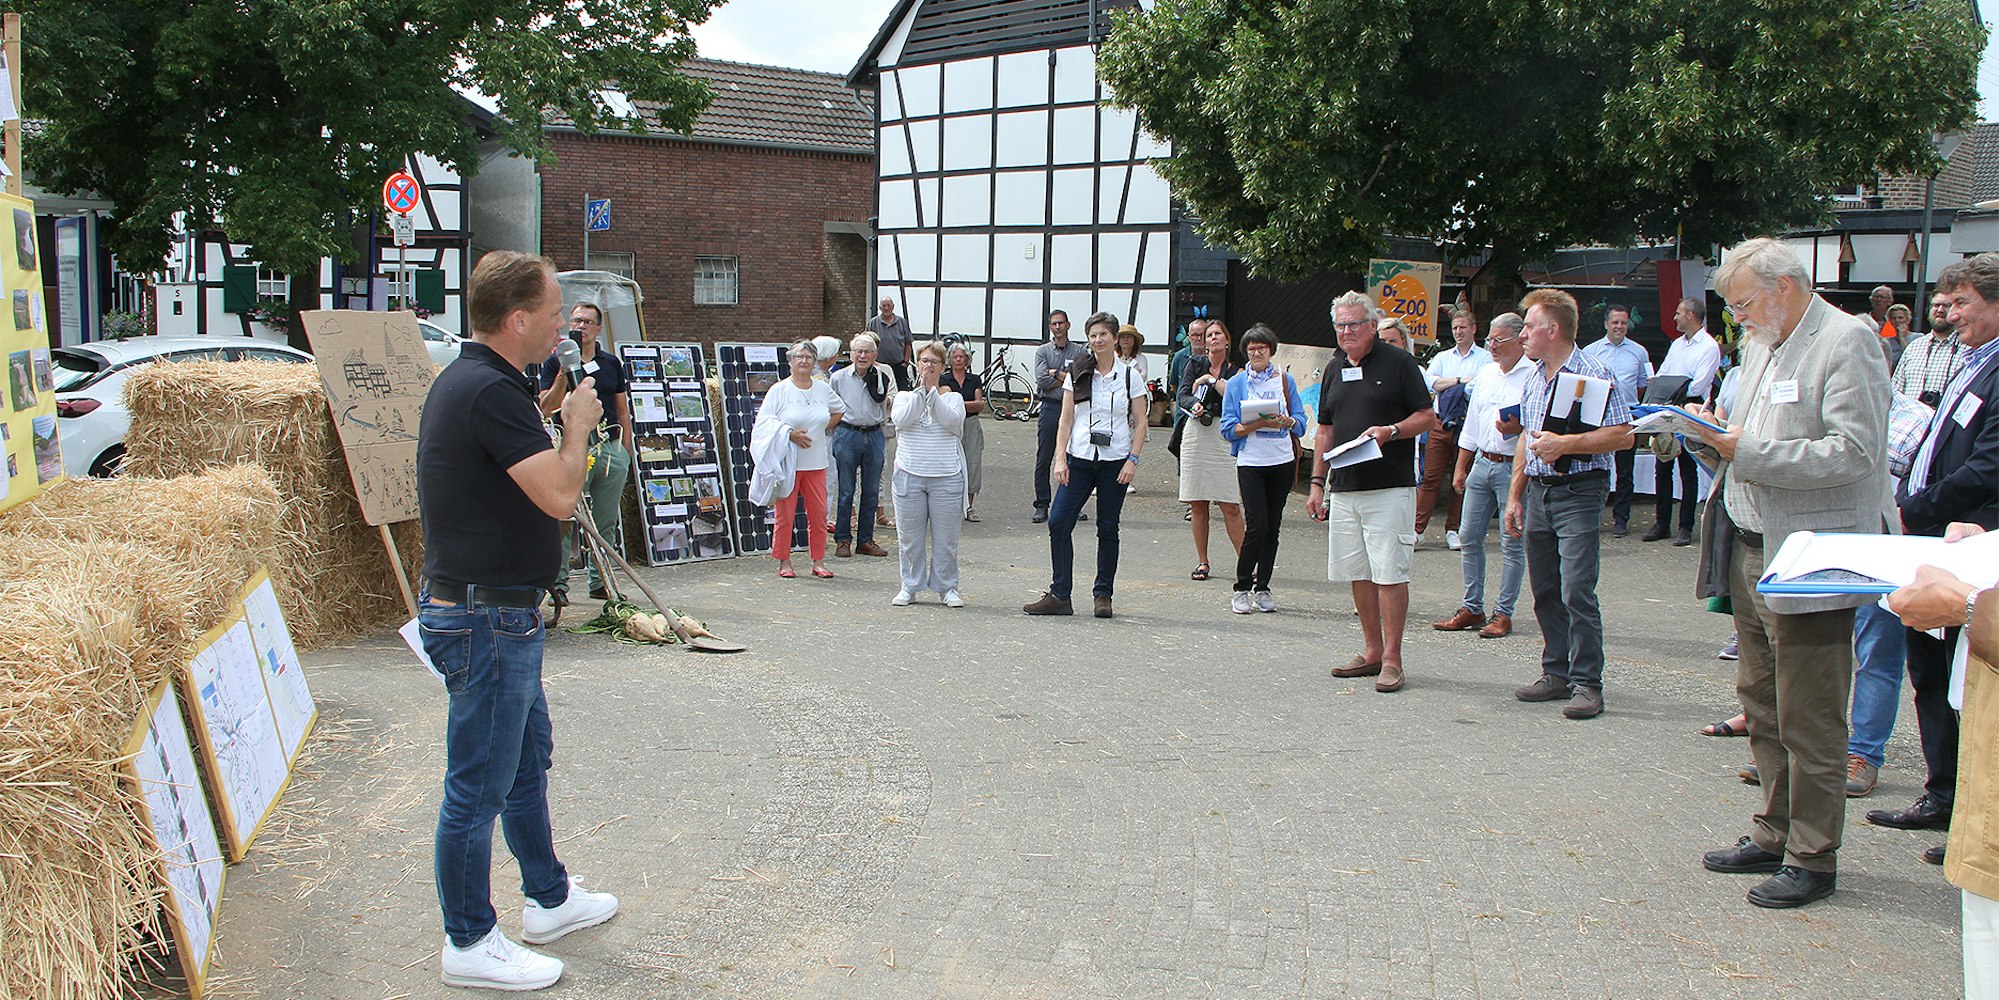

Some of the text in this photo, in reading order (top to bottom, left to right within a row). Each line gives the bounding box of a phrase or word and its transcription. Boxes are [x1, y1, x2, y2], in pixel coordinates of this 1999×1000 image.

[1383, 285, 1397, 297] Dr
[1393, 299, 1426, 316] ZOO
[1407, 320, 1428, 336] ütt
